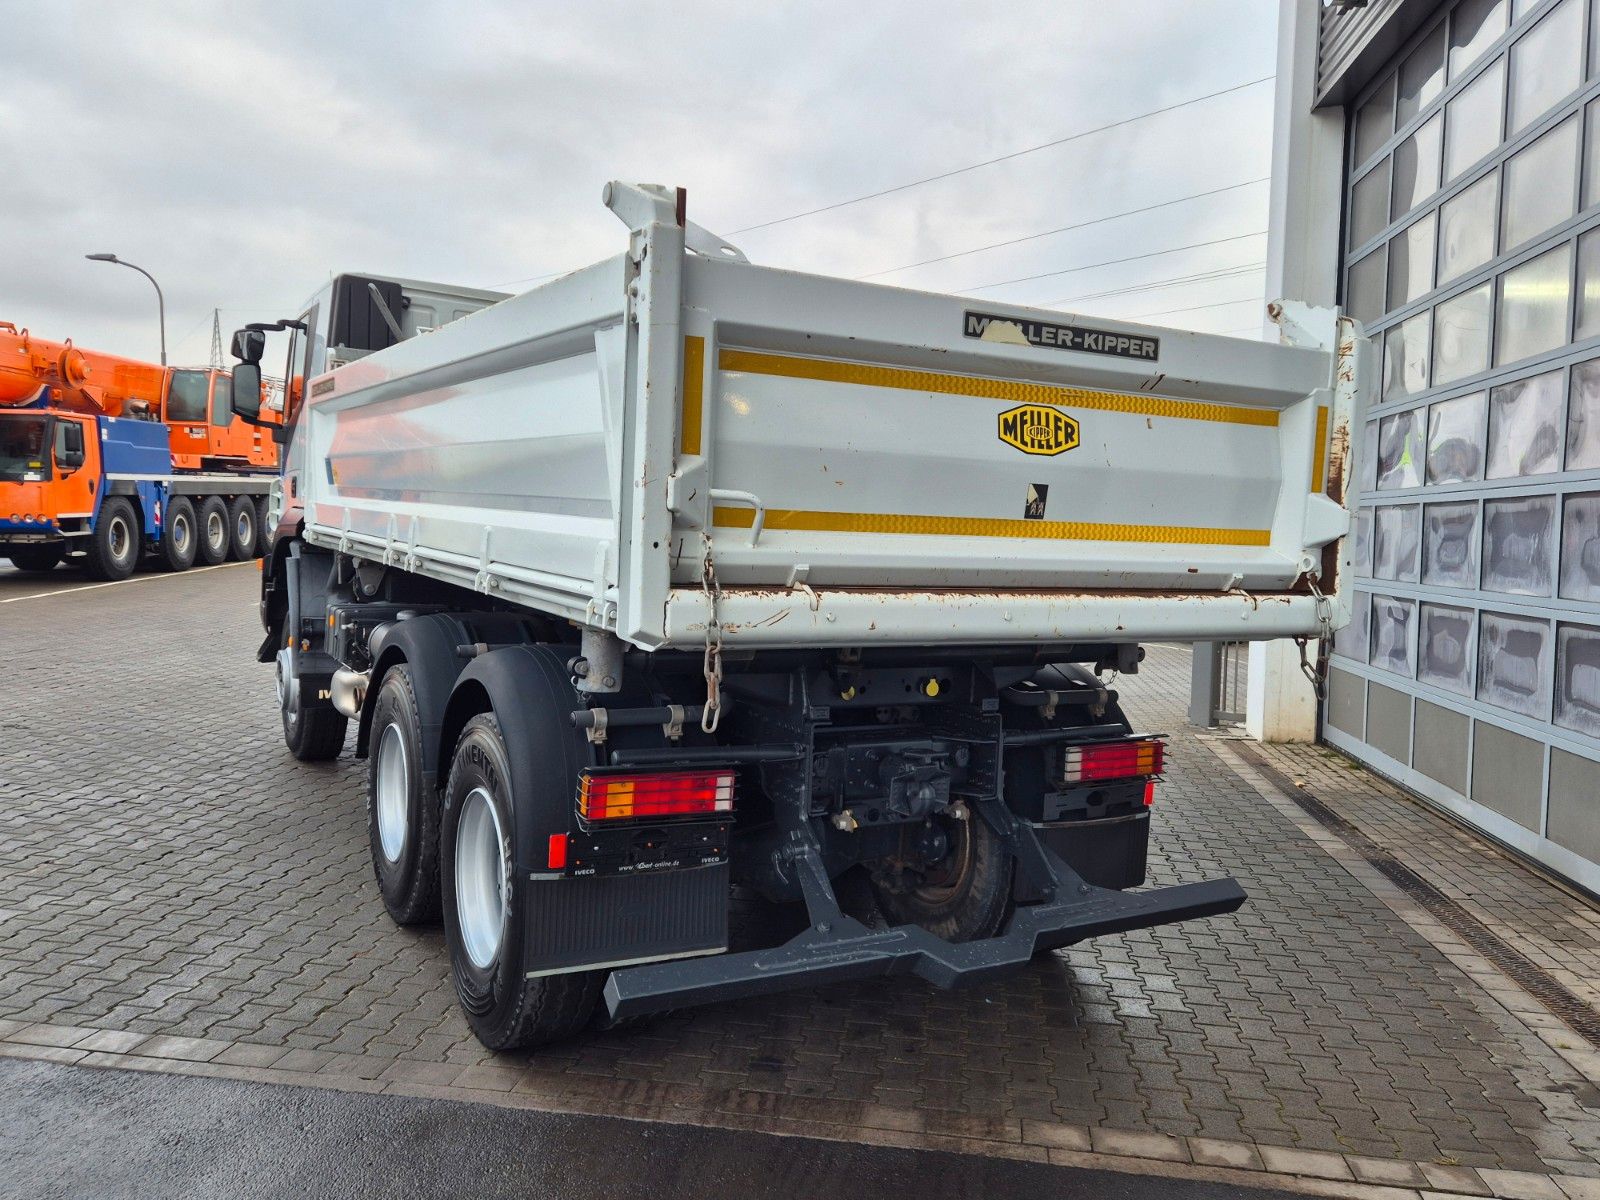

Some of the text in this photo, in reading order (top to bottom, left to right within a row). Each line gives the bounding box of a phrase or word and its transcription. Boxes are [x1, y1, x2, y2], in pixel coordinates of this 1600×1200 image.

[967, 316, 1155, 358] MLER-KIPPER
[1003, 410, 1076, 451] MEILLER
[1028, 425, 1051, 440] KIPPER
[701, 856, 720, 864] IVECO
[574, 868, 596, 876] IVECO
